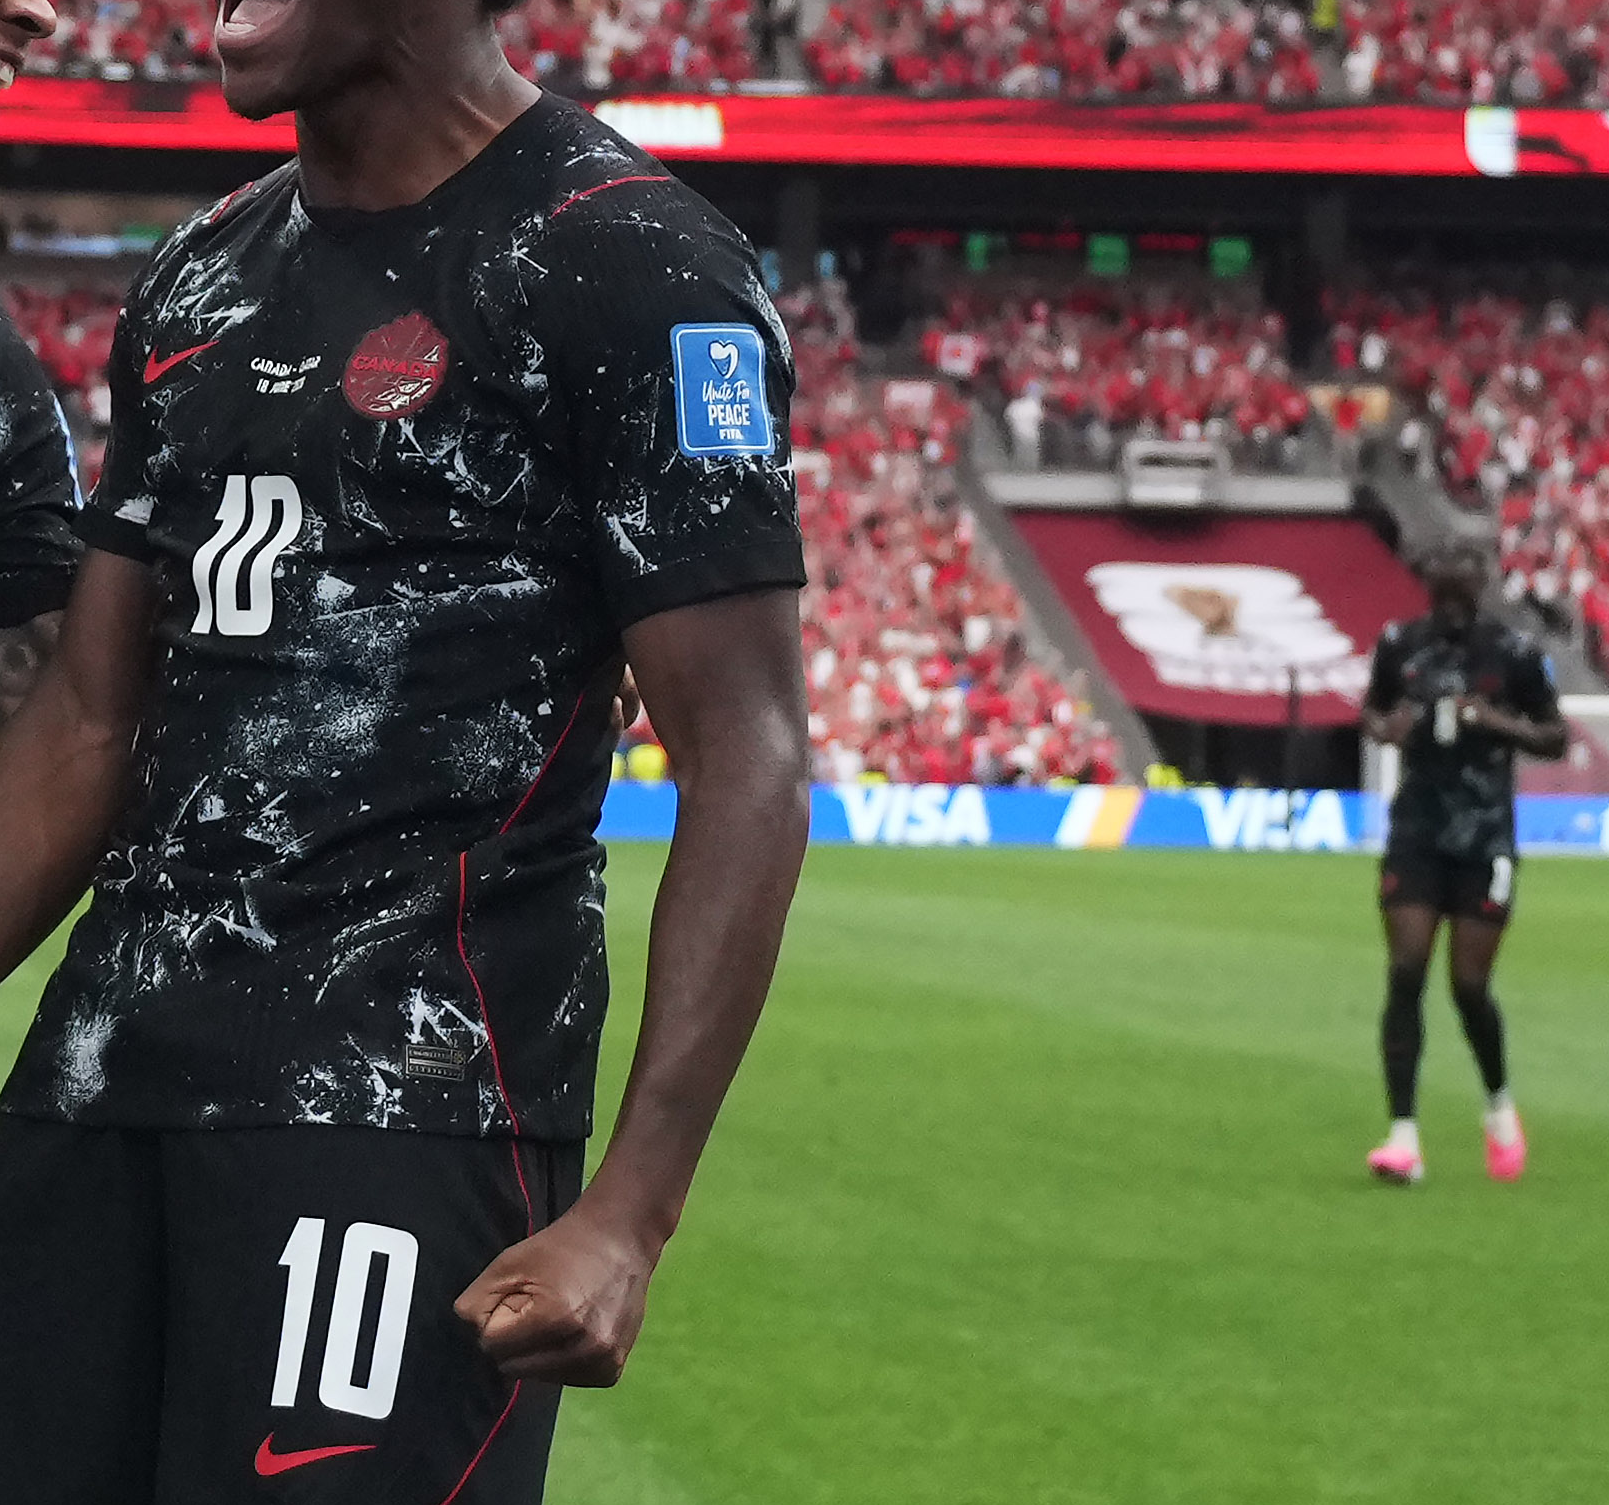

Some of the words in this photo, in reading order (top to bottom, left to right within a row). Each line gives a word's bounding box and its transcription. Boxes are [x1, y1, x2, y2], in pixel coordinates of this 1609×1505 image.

[256, 377, 270, 394] 18
[352, 353, 438, 380] CANADA
[707, 403, 751, 426] PEACE
[190, 474, 303, 636] 10
[833, 783, 992, 845] VISA
[1193, 787, 1351, 851] VISA
[271, 1217, 419, 1420] 10
